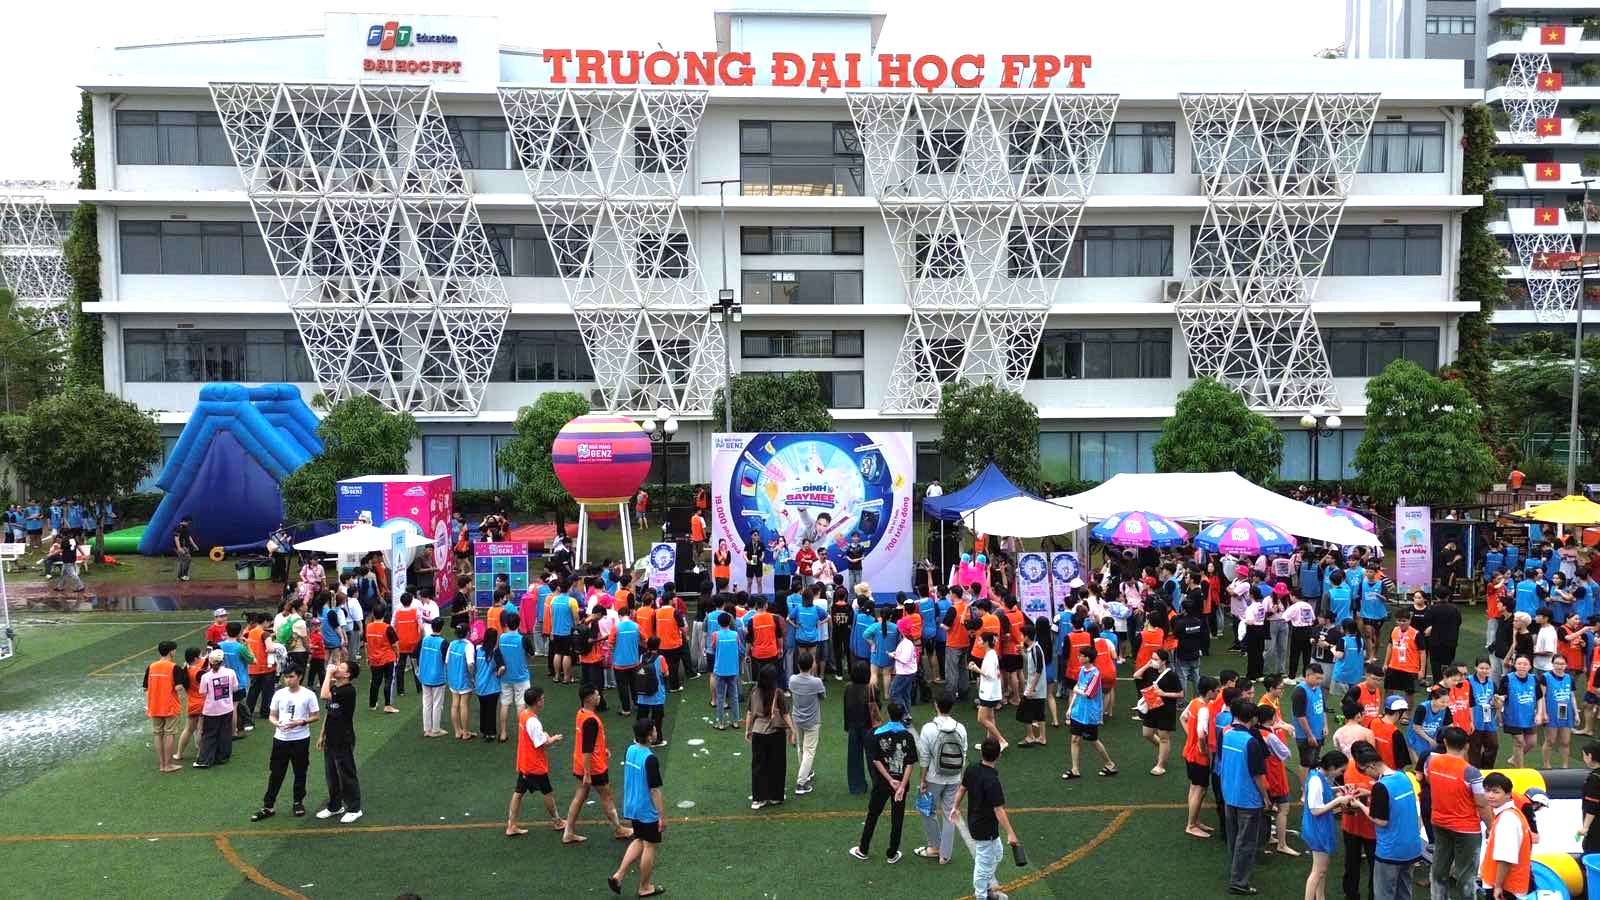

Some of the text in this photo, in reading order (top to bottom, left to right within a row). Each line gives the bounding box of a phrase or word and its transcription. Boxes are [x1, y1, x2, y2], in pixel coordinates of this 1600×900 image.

[368, 26, 458, 44] FPT Education
[363, 59, 461, 75] ĐẠI HỌC FPT
[543, 42, 1092, 94] TRƯỜNG ĐẠI HỌC FPT
